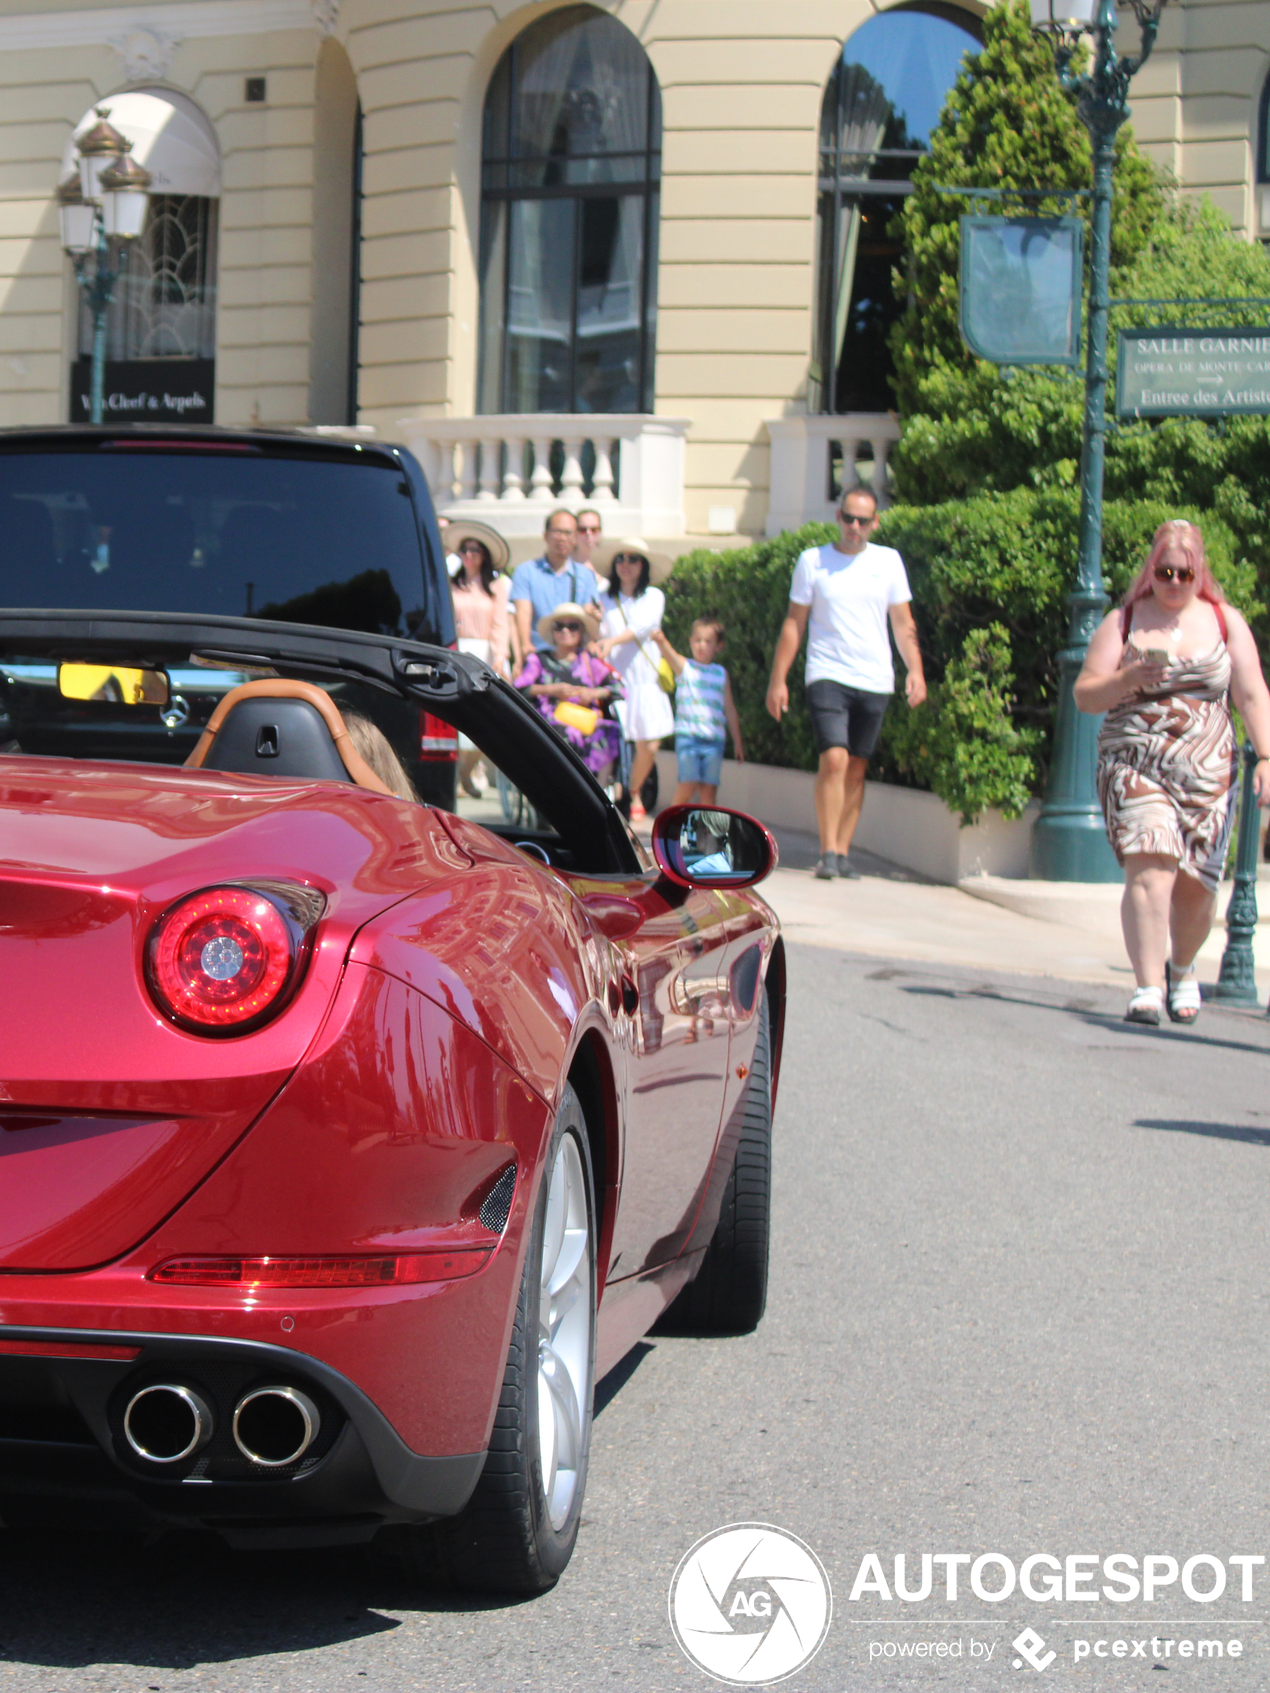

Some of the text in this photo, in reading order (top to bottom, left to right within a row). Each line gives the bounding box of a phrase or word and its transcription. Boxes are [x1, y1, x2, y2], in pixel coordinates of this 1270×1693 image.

[1137, 338, 1196, 354] SALLE
[1134, 362, 1174, 374] OPERA
[1179, 361, 1197, 373] DE
[161, 391, 206, 414] Arpels
[1141, 389, 1190, 405] Entree
[1193, 388, 1219, 405] des
